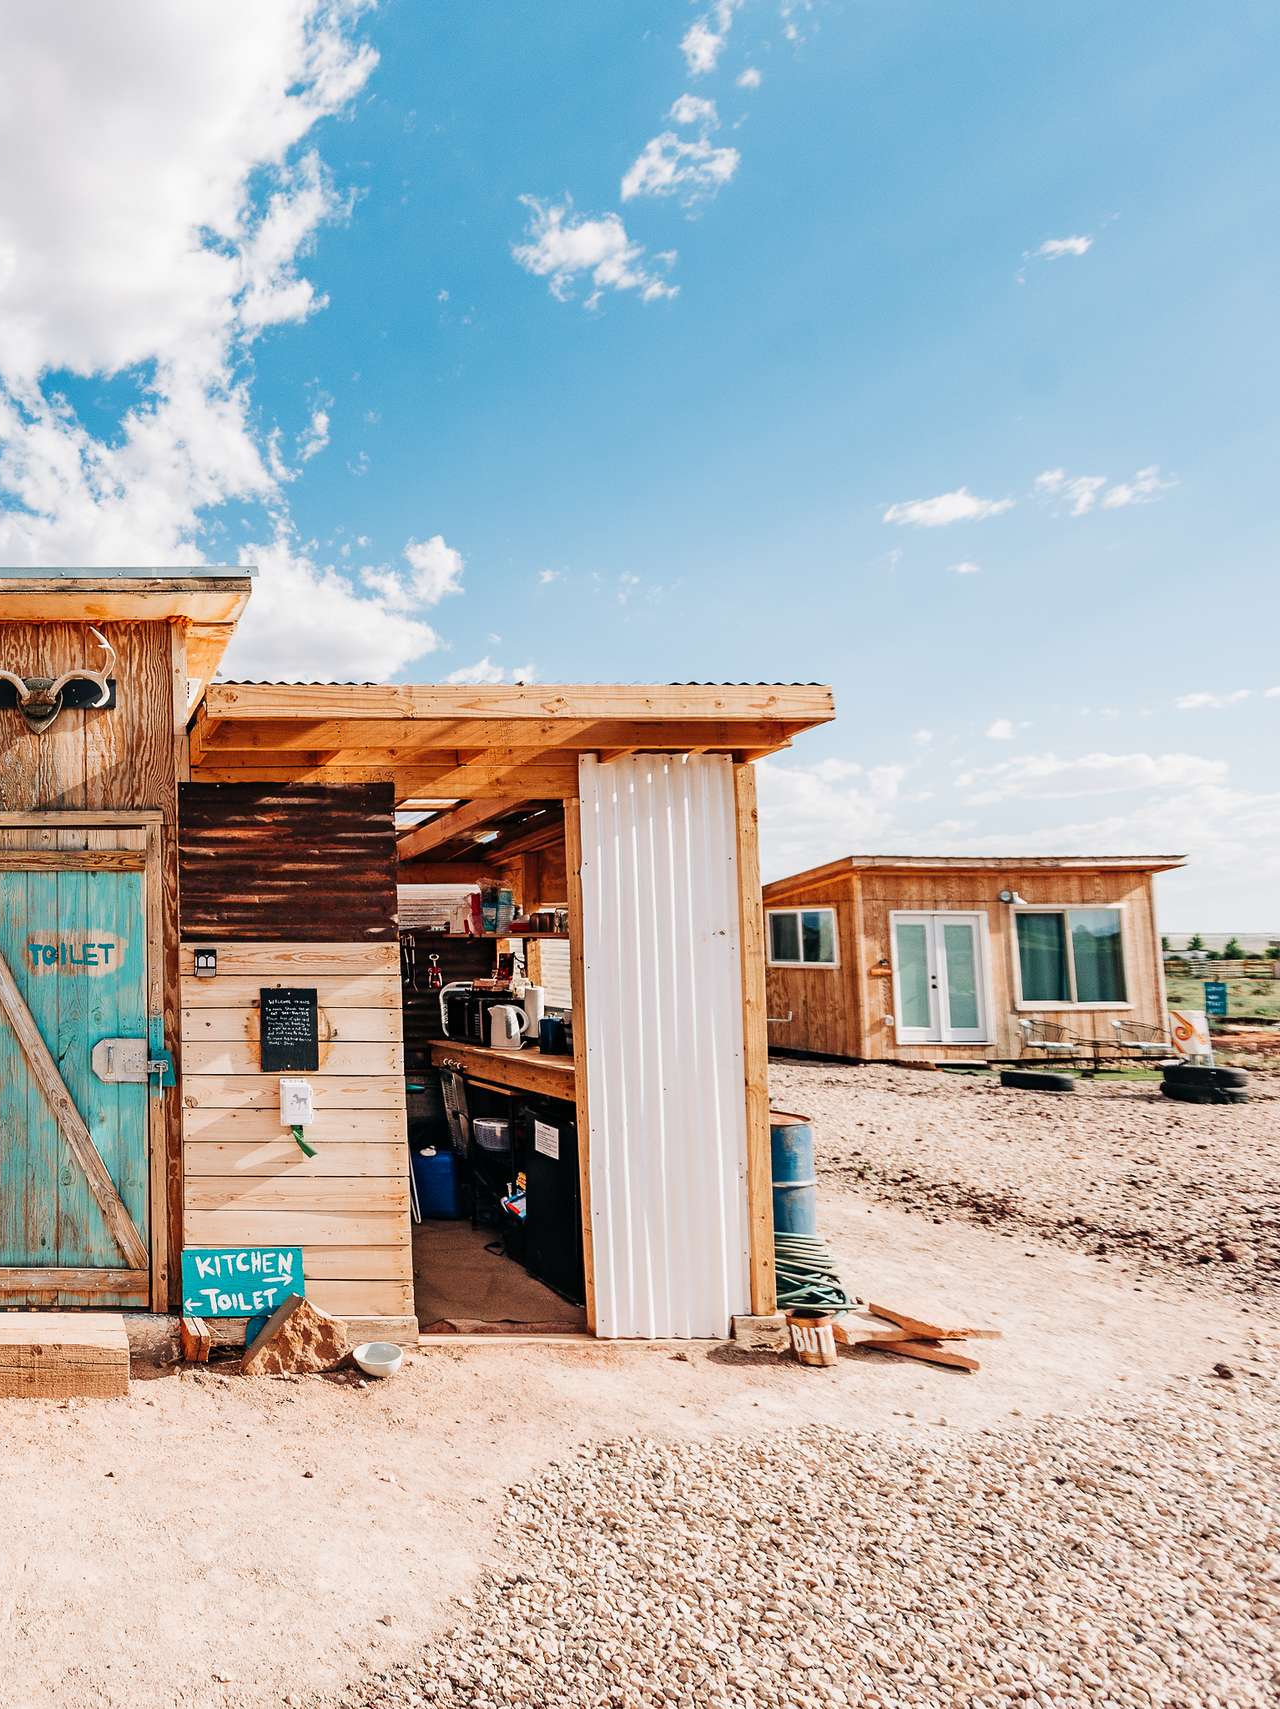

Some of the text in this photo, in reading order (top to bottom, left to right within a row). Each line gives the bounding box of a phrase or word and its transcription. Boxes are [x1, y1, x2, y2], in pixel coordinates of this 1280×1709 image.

[27, 942, 115, 967] TOILET
[194, 1250, 294, 1280] KITCHEN
[199, 1287, 278, 1315] TOILET
